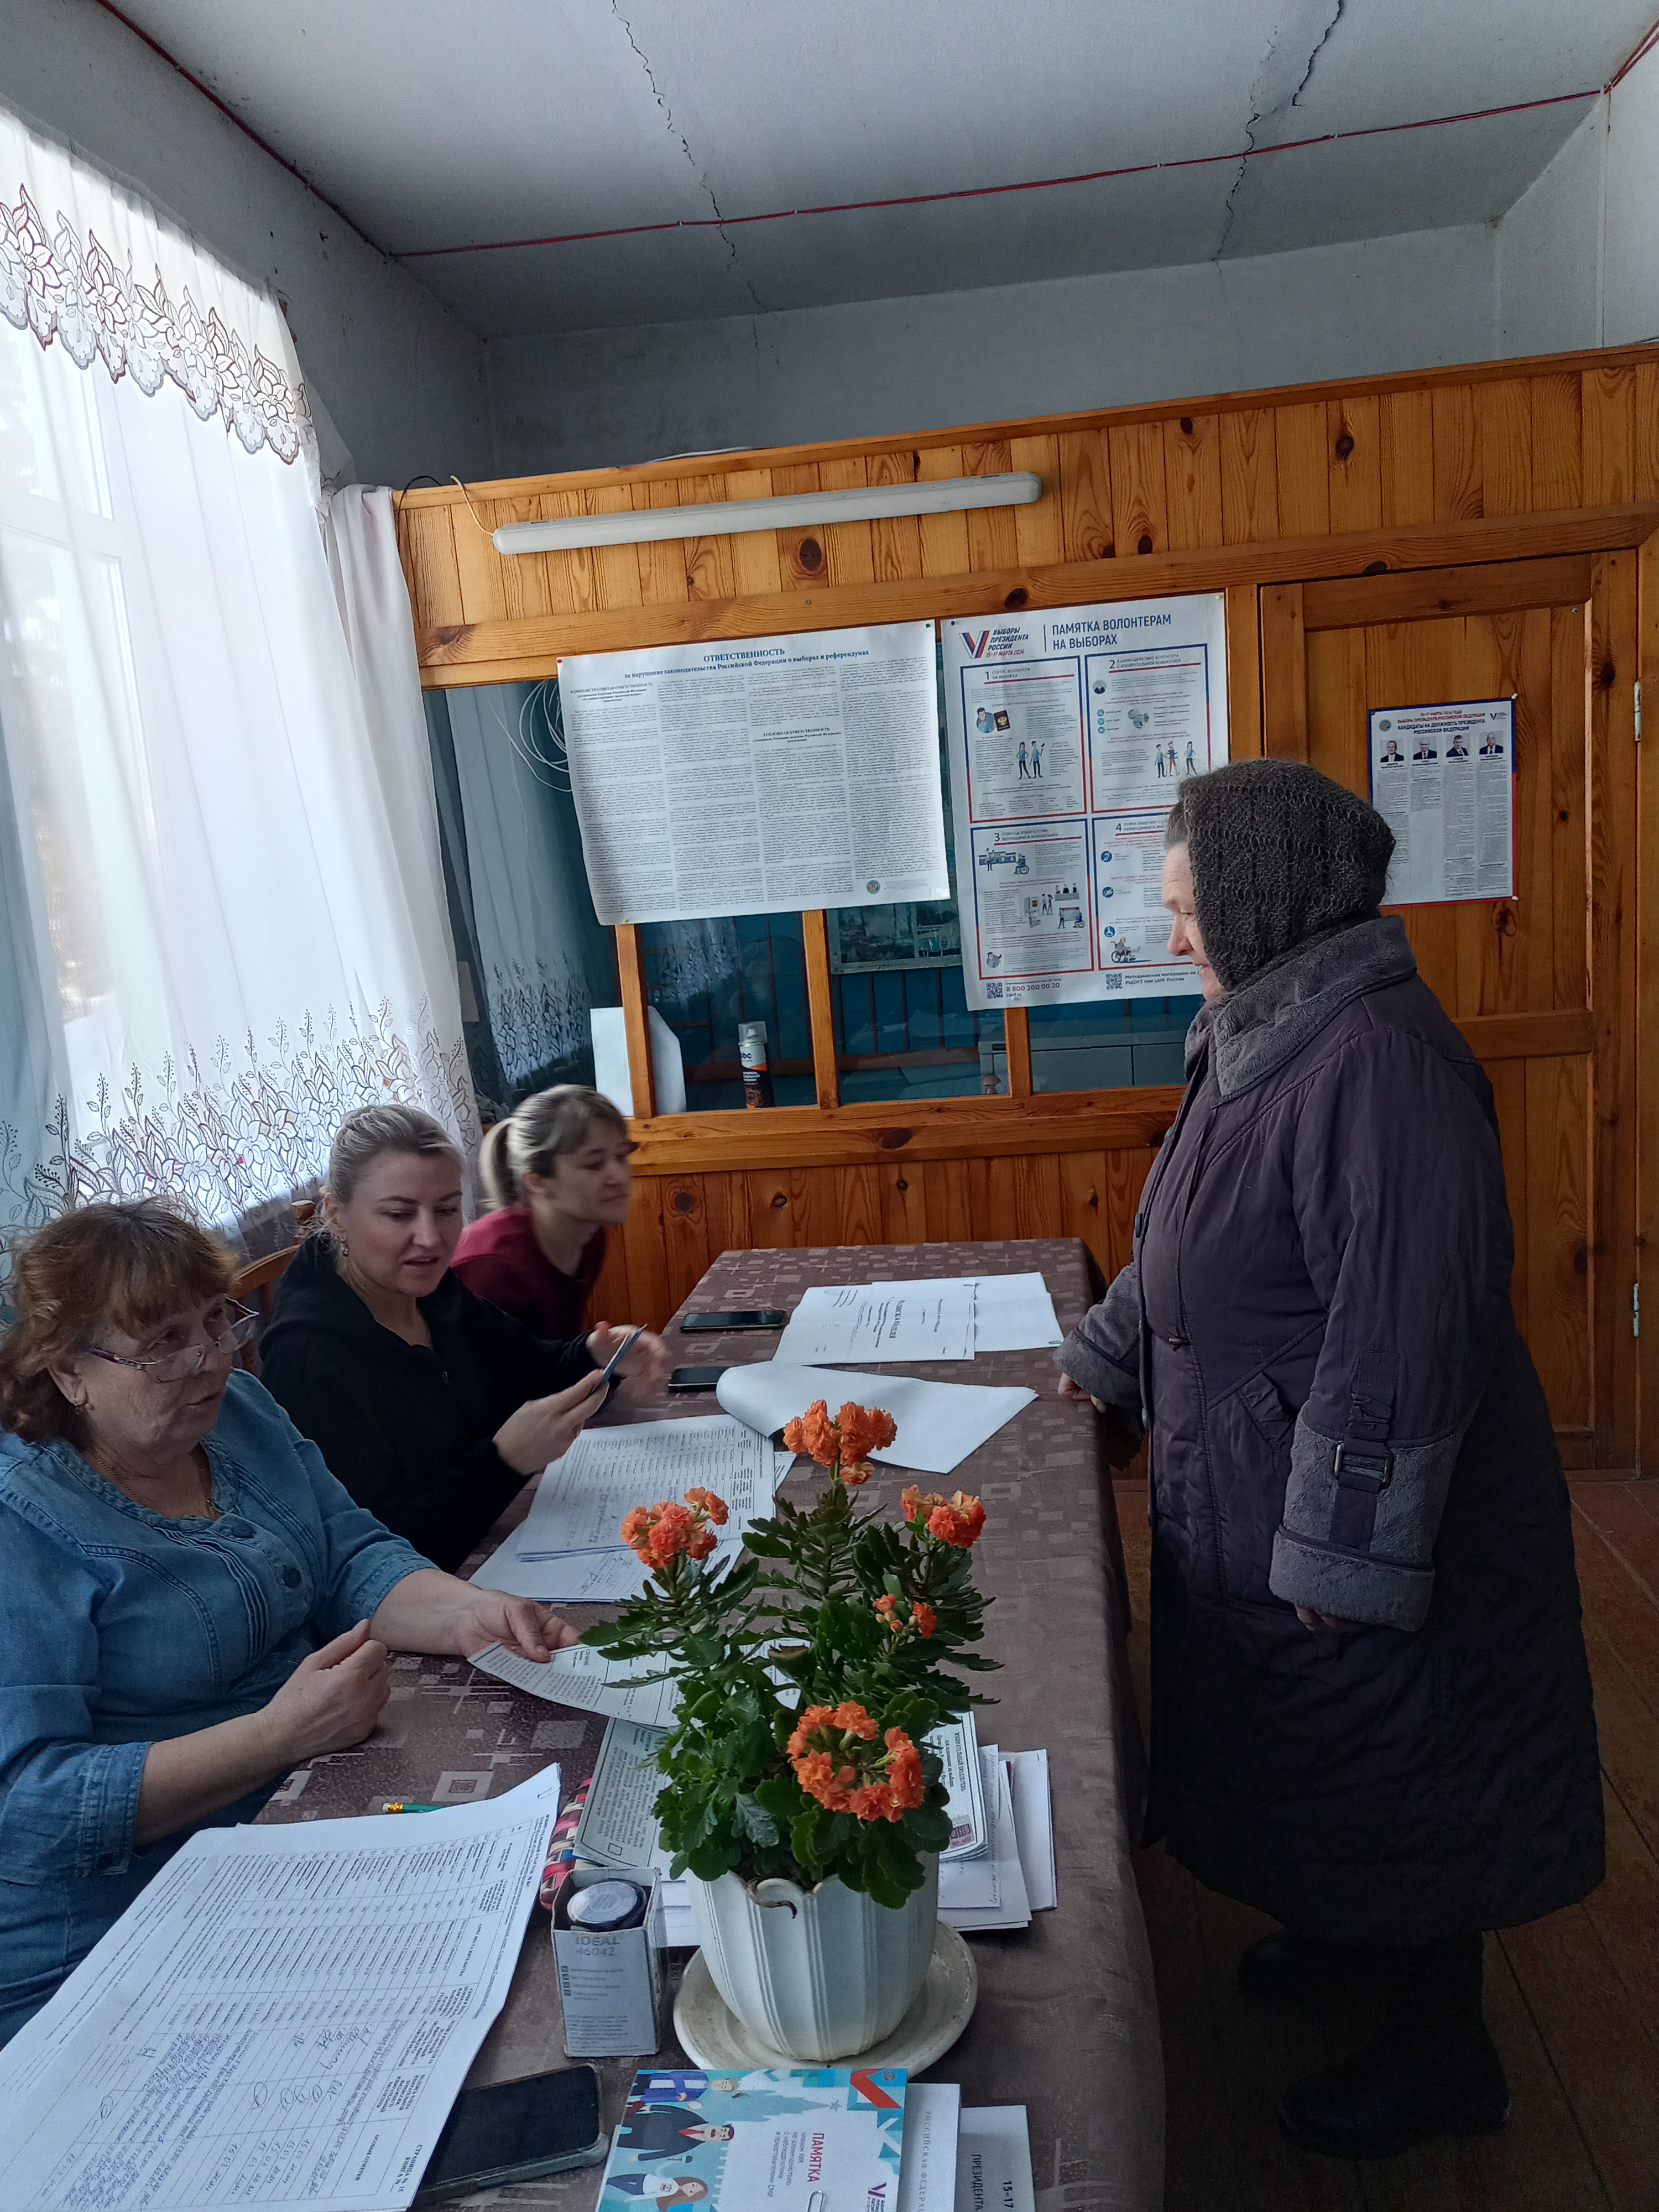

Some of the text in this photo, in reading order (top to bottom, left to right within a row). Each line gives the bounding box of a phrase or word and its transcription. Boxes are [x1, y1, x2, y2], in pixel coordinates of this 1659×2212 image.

[993, 627, 1020, 635] ВЫБОРЫ
[1052, 614, 1171, 635] ПАМЯТКА ВОЛОНТЕРАМ
[990, 634, 1029, 643] ПРЕЗИДЕНТА
[1053, 634, 1118, 650] НА ВЫБОРАХ
[703, 648, 785, 662] ОТВЕТСТВЕННОСТЬ
[632, 670, 664, 679] нарушение
[664, 665, 716, 675] законодательства
[717, 661, 752, 670] Российской
[754, 658, 786, 667] Федерации
[793, 655, 819, 663] выборах
[826, 650, 869, 661] референдумах
[1109, 660, 1115, 669] 2
[985, 671, 989, 680] 1
[1115, 823, 1121, 831] 4
[994, 833, 1000, 841] 3
[576, 1936, 620, 1945] IDEAL
[576, 1947, 615, 1956] 46042
[921, 2111, 932, 2168] РОССИЙСКАЯ
[404, 2145, 423, 2176] СТРАНИЦА
[786, 2140, 797, 2186] взаимодействию
[807, 2132, 825, 2182] ПАМЯТКА
[397, 2157, 411, 2177] КНИГА
[972, 2153, 984, 2211] ПРЕЗИДЕНТА
[1003, 2180, 1014, 2208] 15-17
